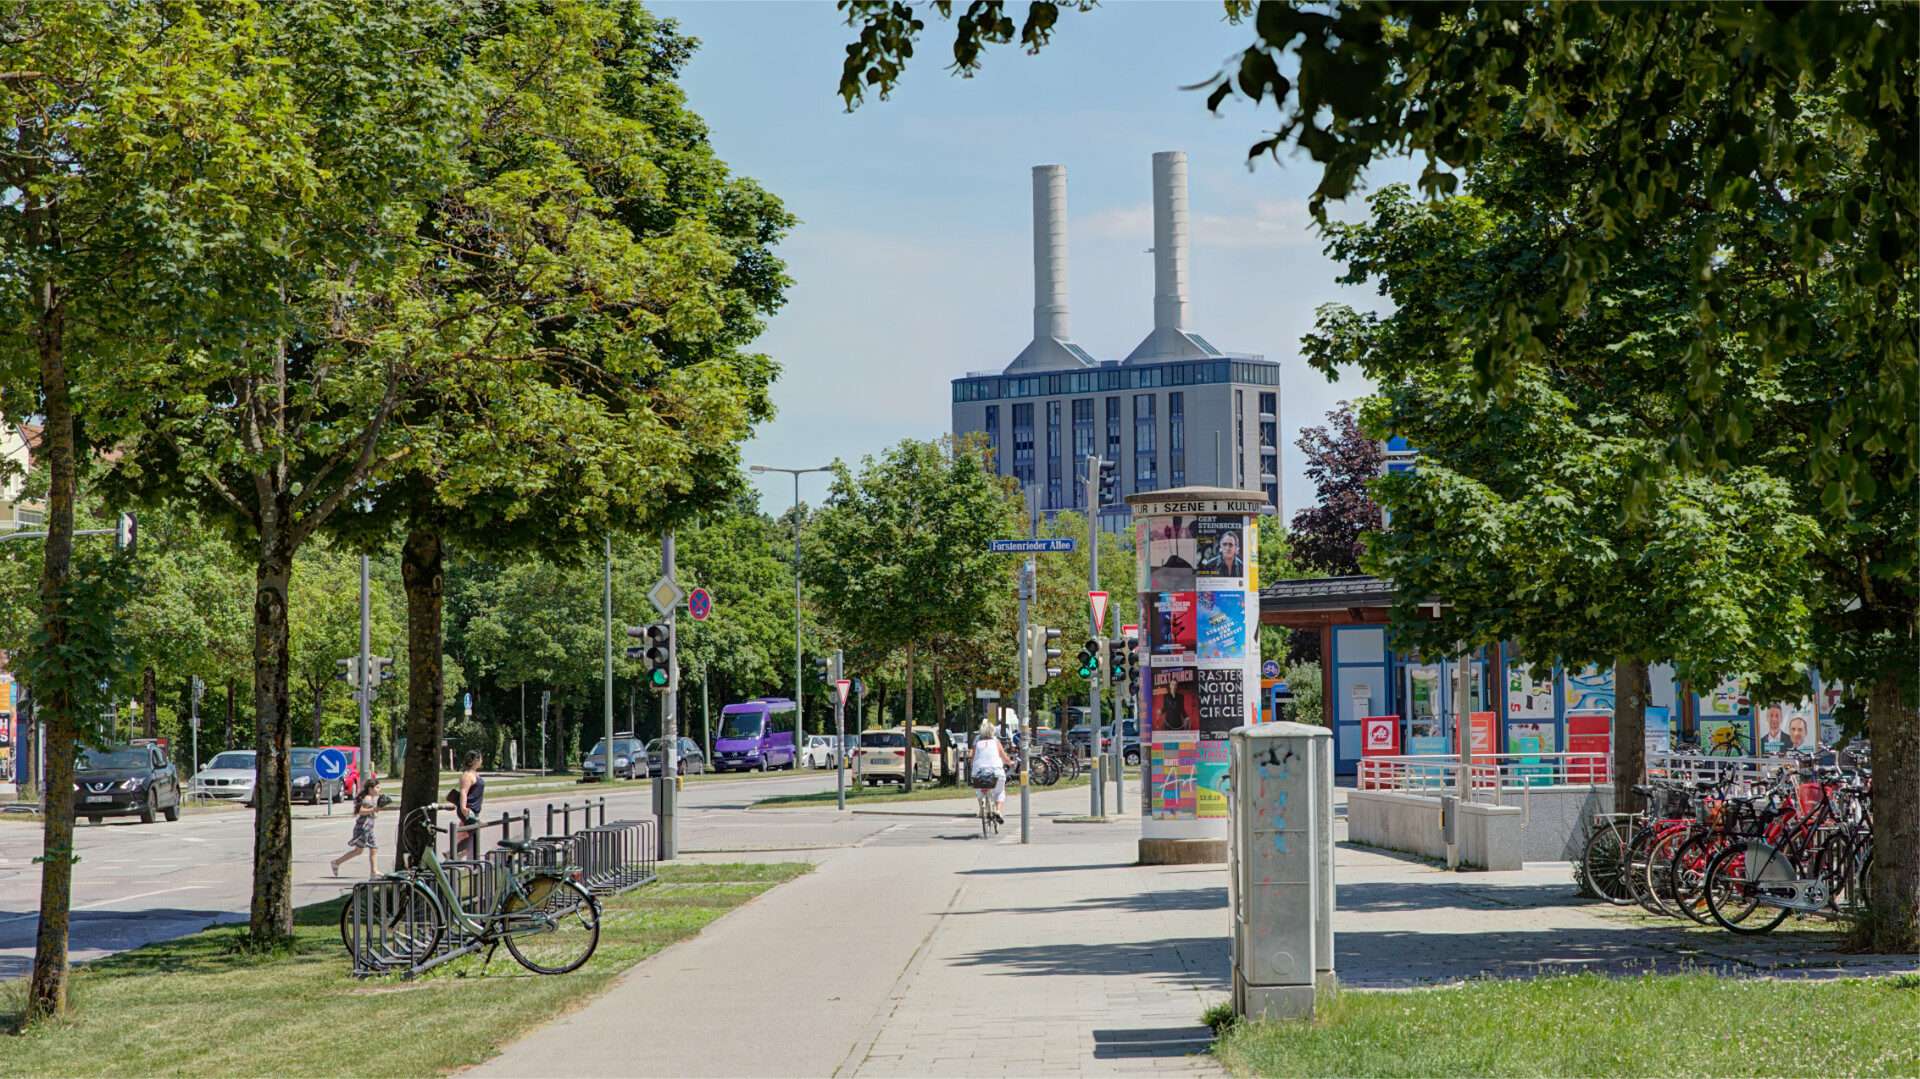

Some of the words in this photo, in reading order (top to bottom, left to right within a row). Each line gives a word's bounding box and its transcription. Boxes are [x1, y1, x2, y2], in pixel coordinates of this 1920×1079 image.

[1164, 502, 1205, 512] SZENE
[992, 541, 1046, 551] Forstenrieder
[1050, 541, 1071, 550] Allee
[1199, 670, 1243, 681] RASTER
[1199, 682, 1243, 693] NOTON
[1200, 694, 1243, 704] WHITE
[1200, 706, 1244, 717] CIRCLE
